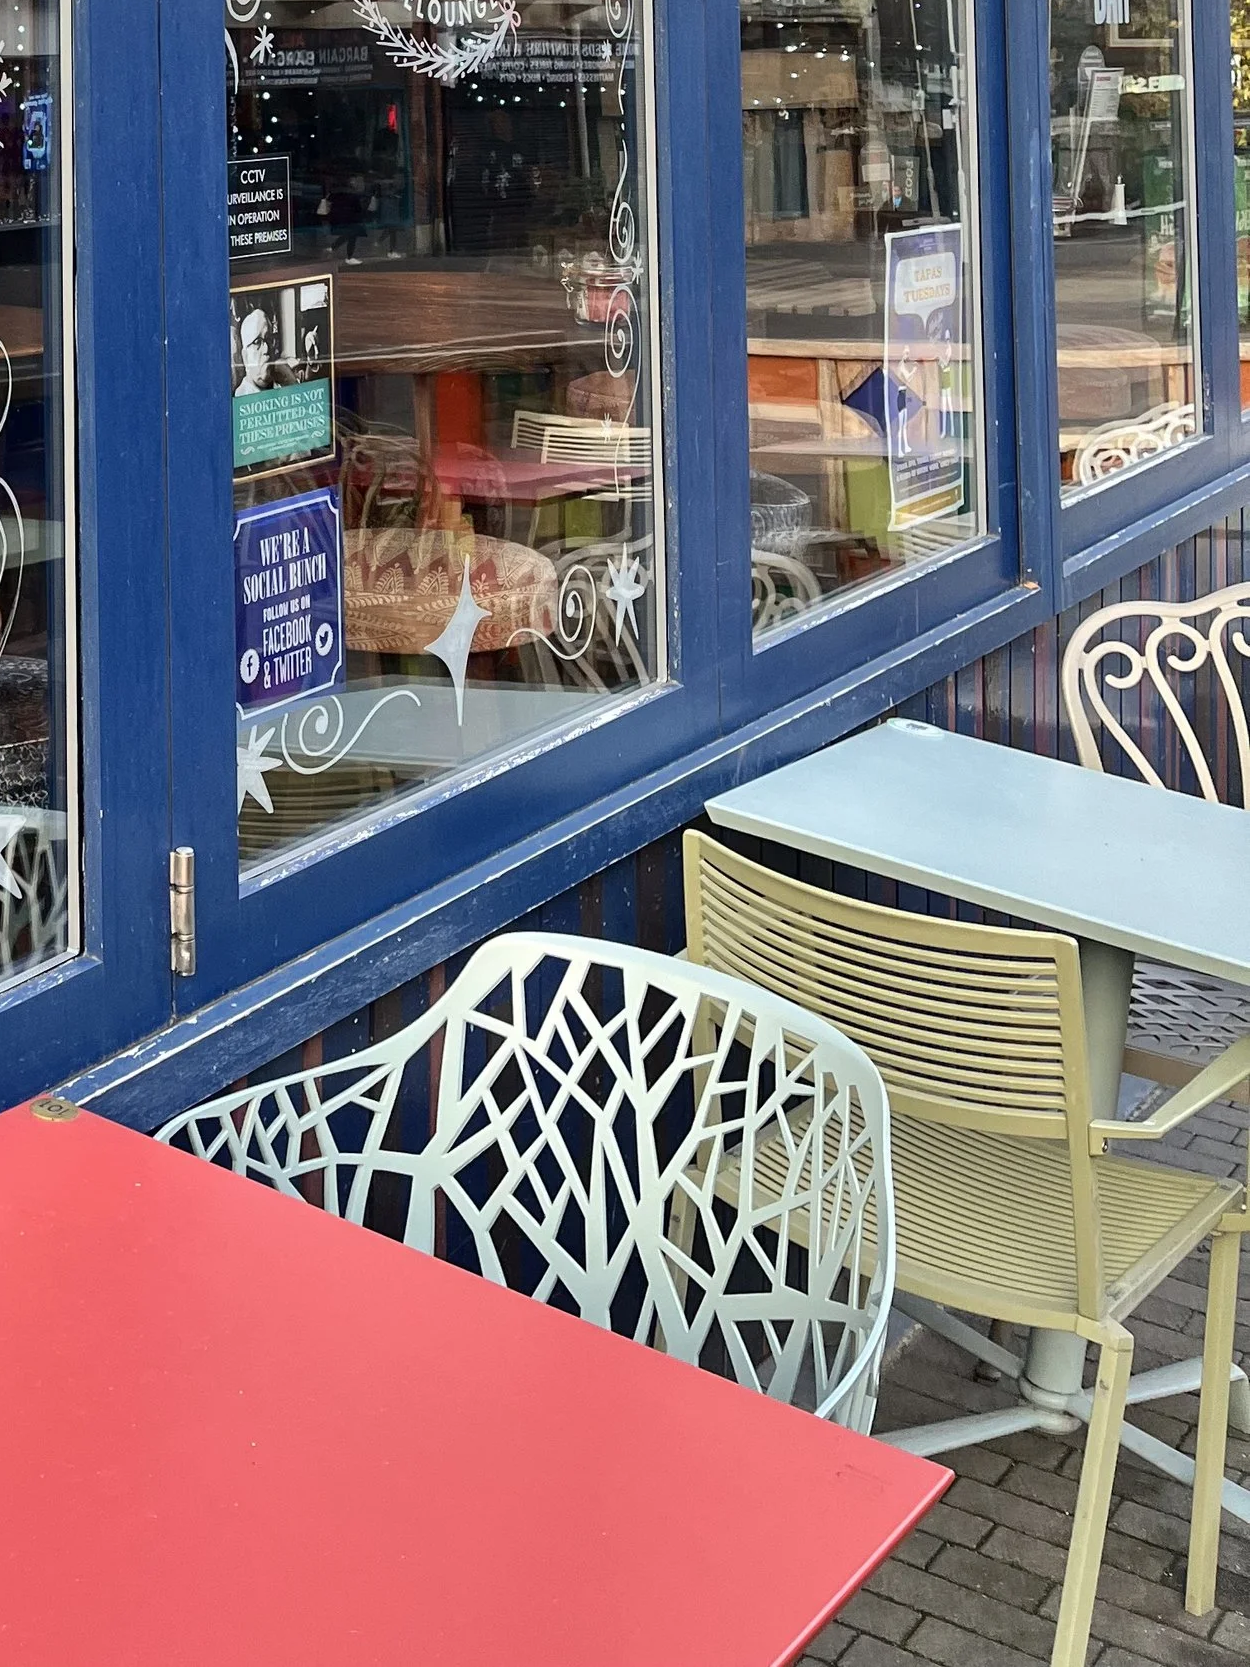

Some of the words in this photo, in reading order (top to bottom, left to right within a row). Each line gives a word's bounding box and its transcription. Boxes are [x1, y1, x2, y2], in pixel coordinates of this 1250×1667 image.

[240, 168, 265, 184] CCTV
[227, 189, 276, 205] URVEILLANCE
[276, 188, 284, 200] IS
[228, 214, 236, 226] IN
[237, 209, 280, 225] OPERATION
[230, 233, 254, 247] THESE
[254, 229, 288, 244] PREMISES
[904, 283, 951, 303] TUESDAYS
[239, 395, 289, 417] SMOKING
[291, 393, 301, 406] IS
[302, 387, 325, 404] NOT
[239, 406, 306, 431] PERMITTED
[308, 401, 325, 415] ON
[239, 427, 274, 446] THESE
[275, 414, 326, 437] PREMISES
[260, 529, 301, 567] WE'RE
[301, 526, 311, 555] A
[243, 565, 287, 605] SOCIAL
[288, 552, 327, 592] BUNCH
[262, 604, 289, 624] FOLLOW
[290, 600, 300, 615] US
[300, 593, 311, 611] ON
[262, 614, 312, 658] FACEBOOK
[263, 659, 272, 690] &
[273, 646, 312, 686] TWITTER
